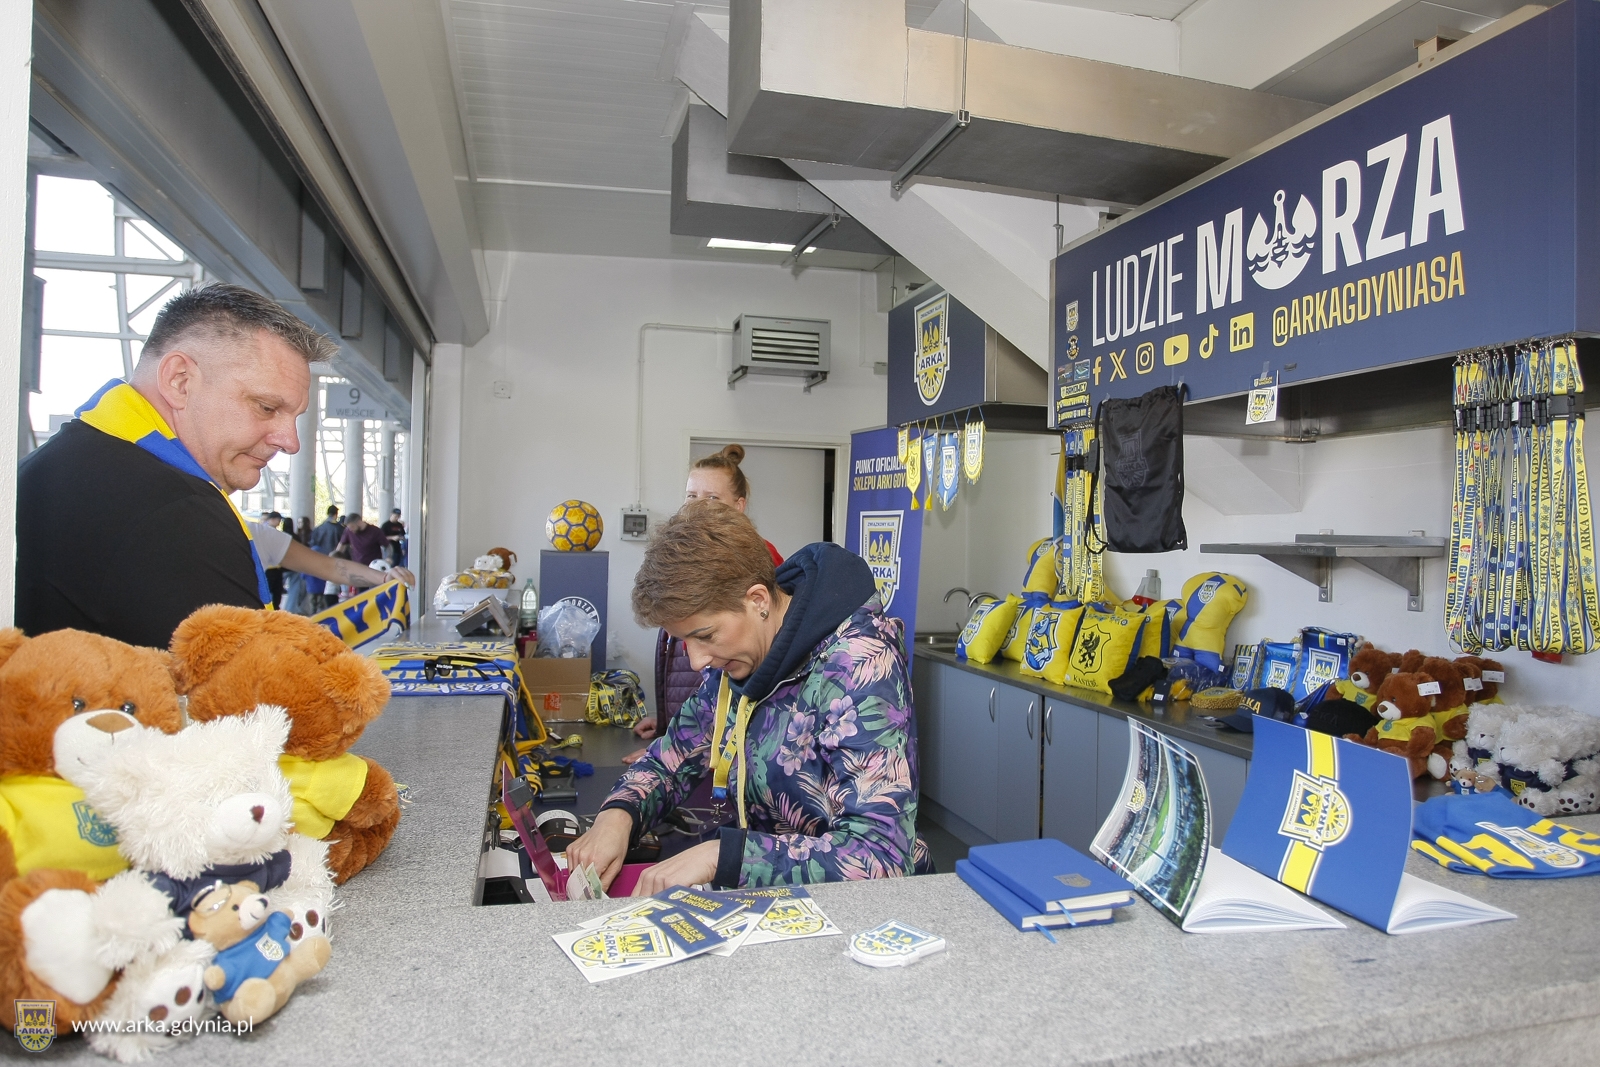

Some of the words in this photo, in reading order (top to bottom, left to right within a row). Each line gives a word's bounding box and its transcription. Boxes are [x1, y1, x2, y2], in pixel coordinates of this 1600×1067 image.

[1091, 233, 1184, 347] LUDZIE
[1271, 250, 1466, 347] @ARKAGDYNIASA
[920, 352, 943, 370] ARKA
[349, 387, 361, 405] 9
[335, 407, 376, 418] WEJŚCIE
[855, 458, 876, 474] PUNKT
[853, 475, 877, 491] SKLEPU
[876, 473, 893, 489] ARKI
[1577, 470, 1589, 515] GDYNIA
[1462, 485, 1476, 539] GDYNIANIE
[1509, 520, 1518, 553] ARKOWCY
[1580, 519, 1592, 551] ARKA
[872, 567, 893, 578] RKA
[1488, 573, 1496, 588] ARKA
[1451, 565, 1468, 617] GDYNIANIE
[1505, 575, 1513, 598] GDYNIA
[1487, 589, 1496, 613] GDYNIA
[1503, 600, 1512, 616] ARKA
[1551, 612, 1560, 644] ARKA
[1316, 793, 1331, 836] ARKA
[687, 894, 723, 909] NAKLEJKI
[679, 920, 706, 941] NAKLEJKI
[769, 916, 815, 926] ARKA
[604, 934, 619, 959] ARKA
[865, 933, 903, 950] ARKA
